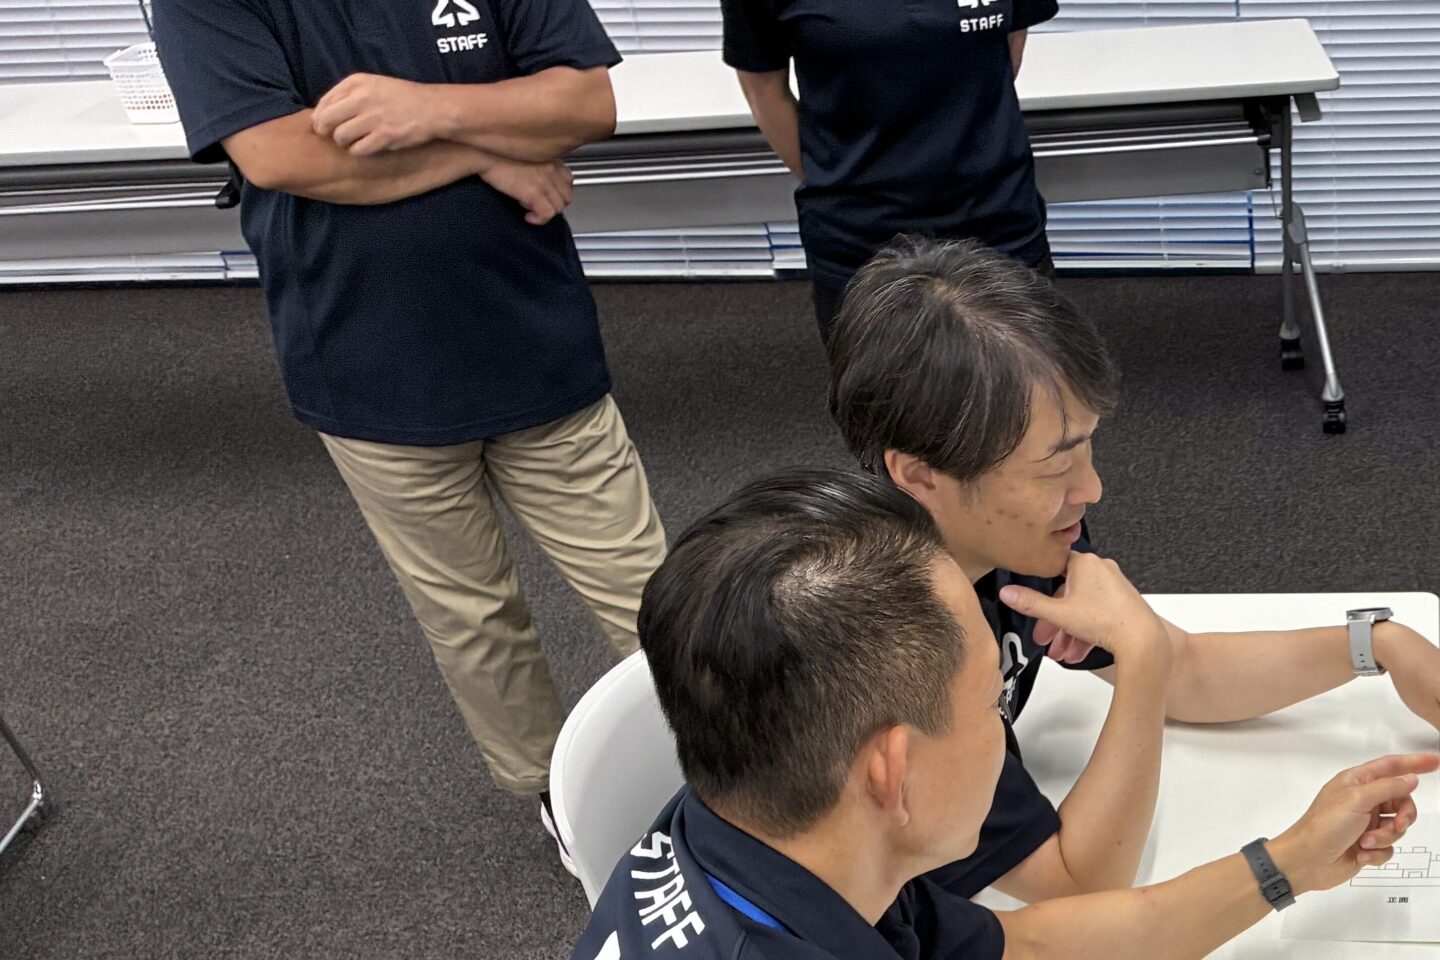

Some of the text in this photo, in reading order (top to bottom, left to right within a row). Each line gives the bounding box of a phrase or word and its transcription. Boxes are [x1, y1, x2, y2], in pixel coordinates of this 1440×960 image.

[960, 13, 1004, 33] STAFF
[437, 33, 488, 53] STAFF
[629, 831, 706, 950] STAFF
[1386, 896, 1409, 904] 正面
